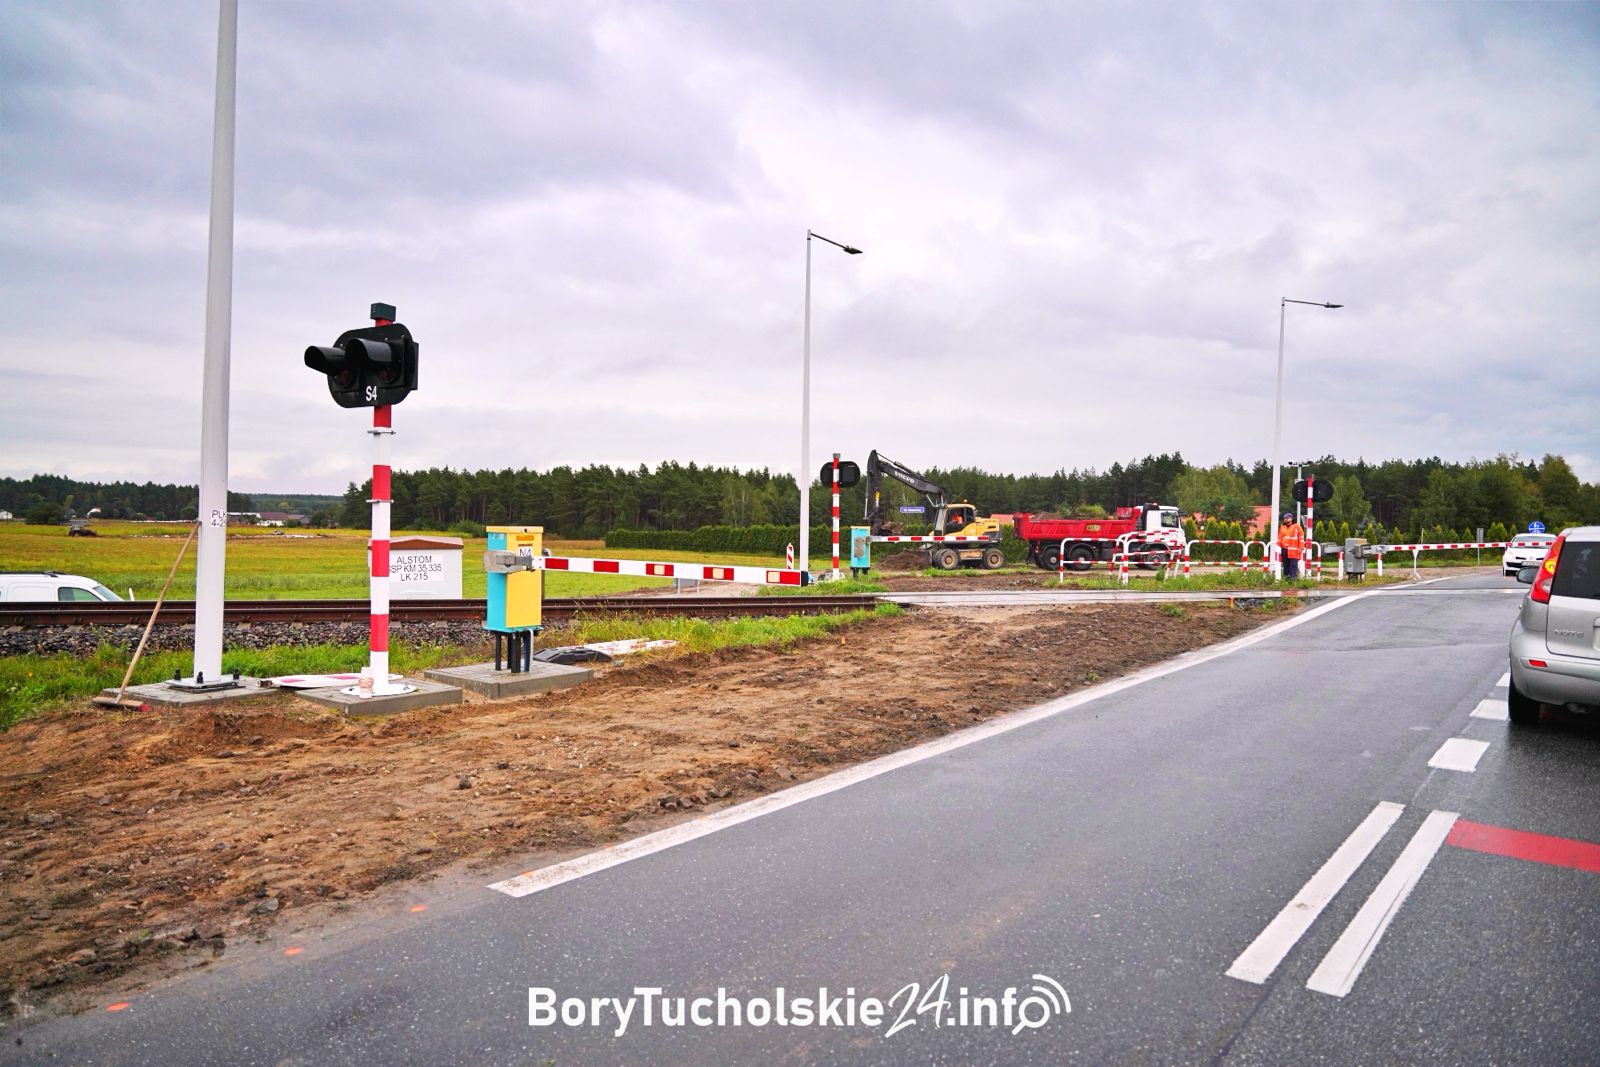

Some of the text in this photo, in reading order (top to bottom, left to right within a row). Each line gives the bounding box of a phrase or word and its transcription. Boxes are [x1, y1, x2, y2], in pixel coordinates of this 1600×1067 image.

[365, 385, 378, 402] S4
[396, 555, 432, 565] ALSTOM
[403, 564, 416, 573] KM
[418, 564, 428, 573] 35
[428, 563, 443, 572] 335
[400, 572, 429, 582] LK 215
